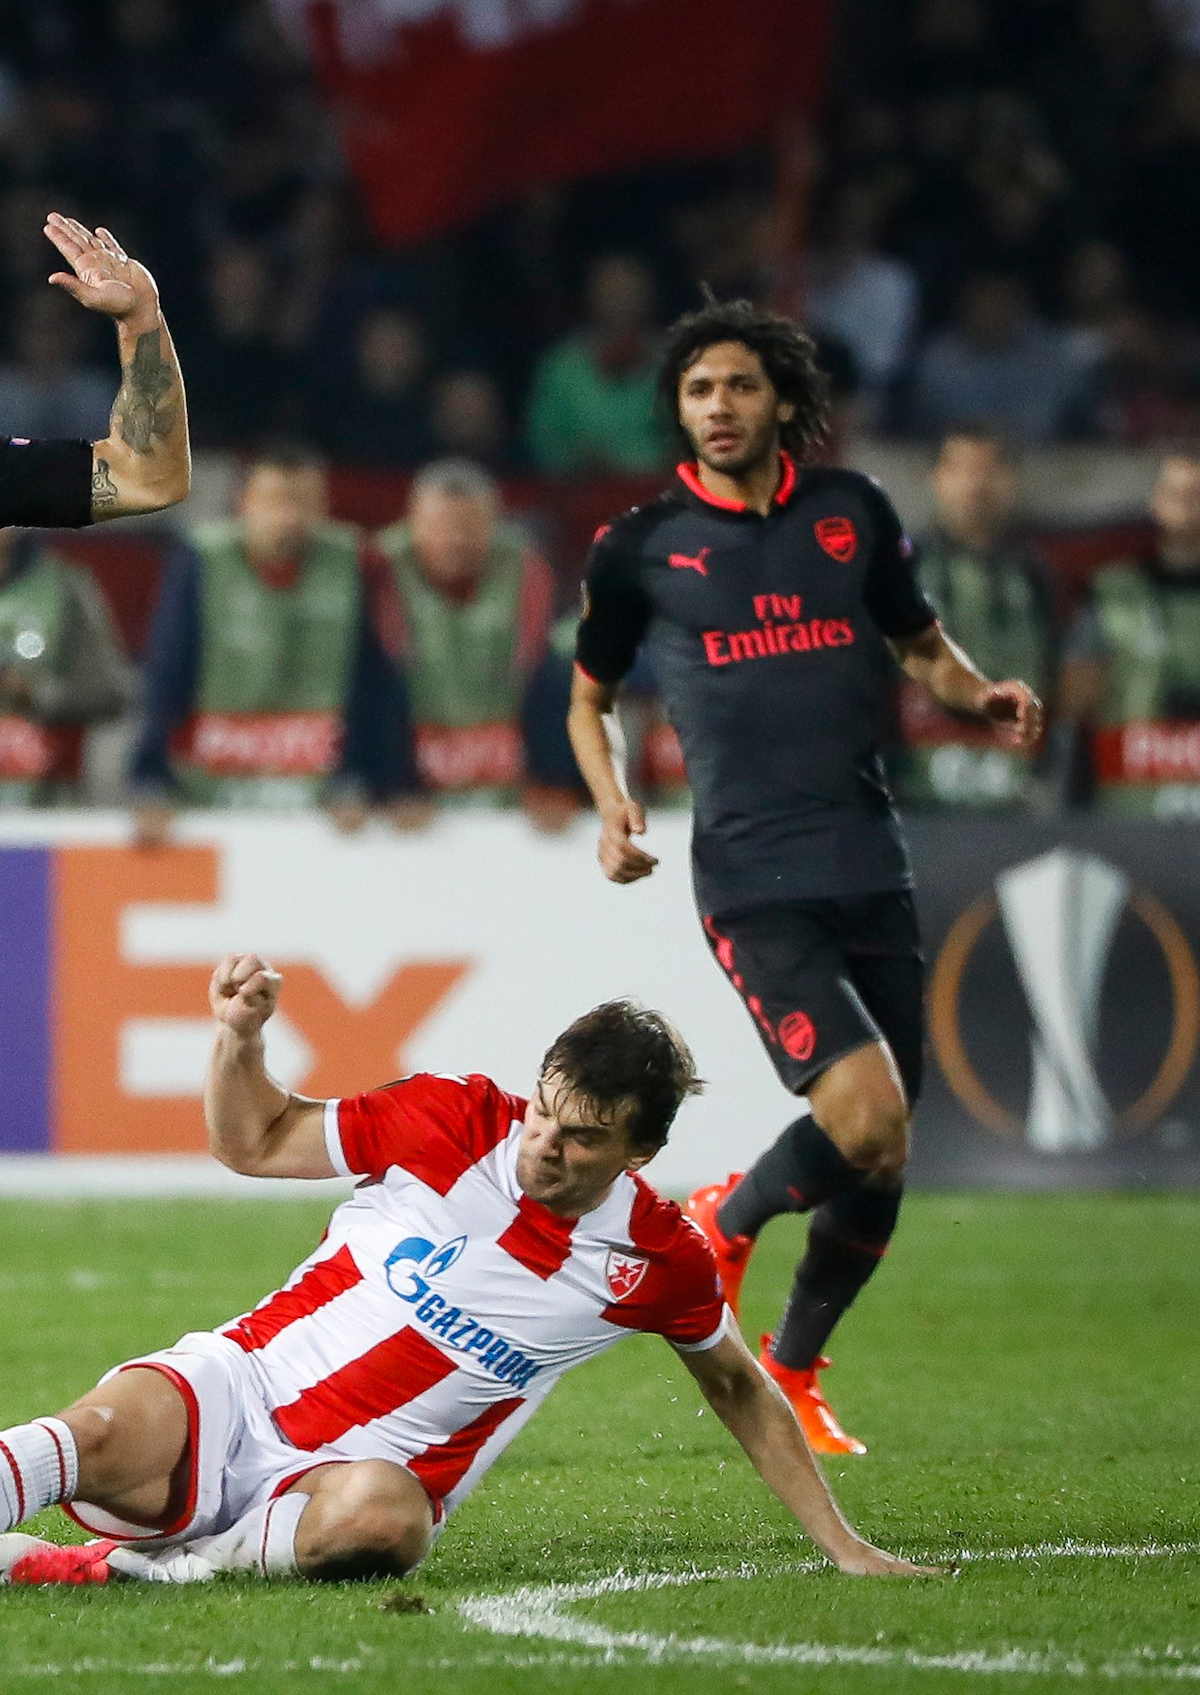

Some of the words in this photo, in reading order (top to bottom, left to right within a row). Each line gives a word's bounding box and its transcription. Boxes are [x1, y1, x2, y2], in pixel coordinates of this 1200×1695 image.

[752, 594, 802, 620] Fly
[702, 619, 855, 667] Emirates
[415, 1294, 538, 1390] GAZPROM
